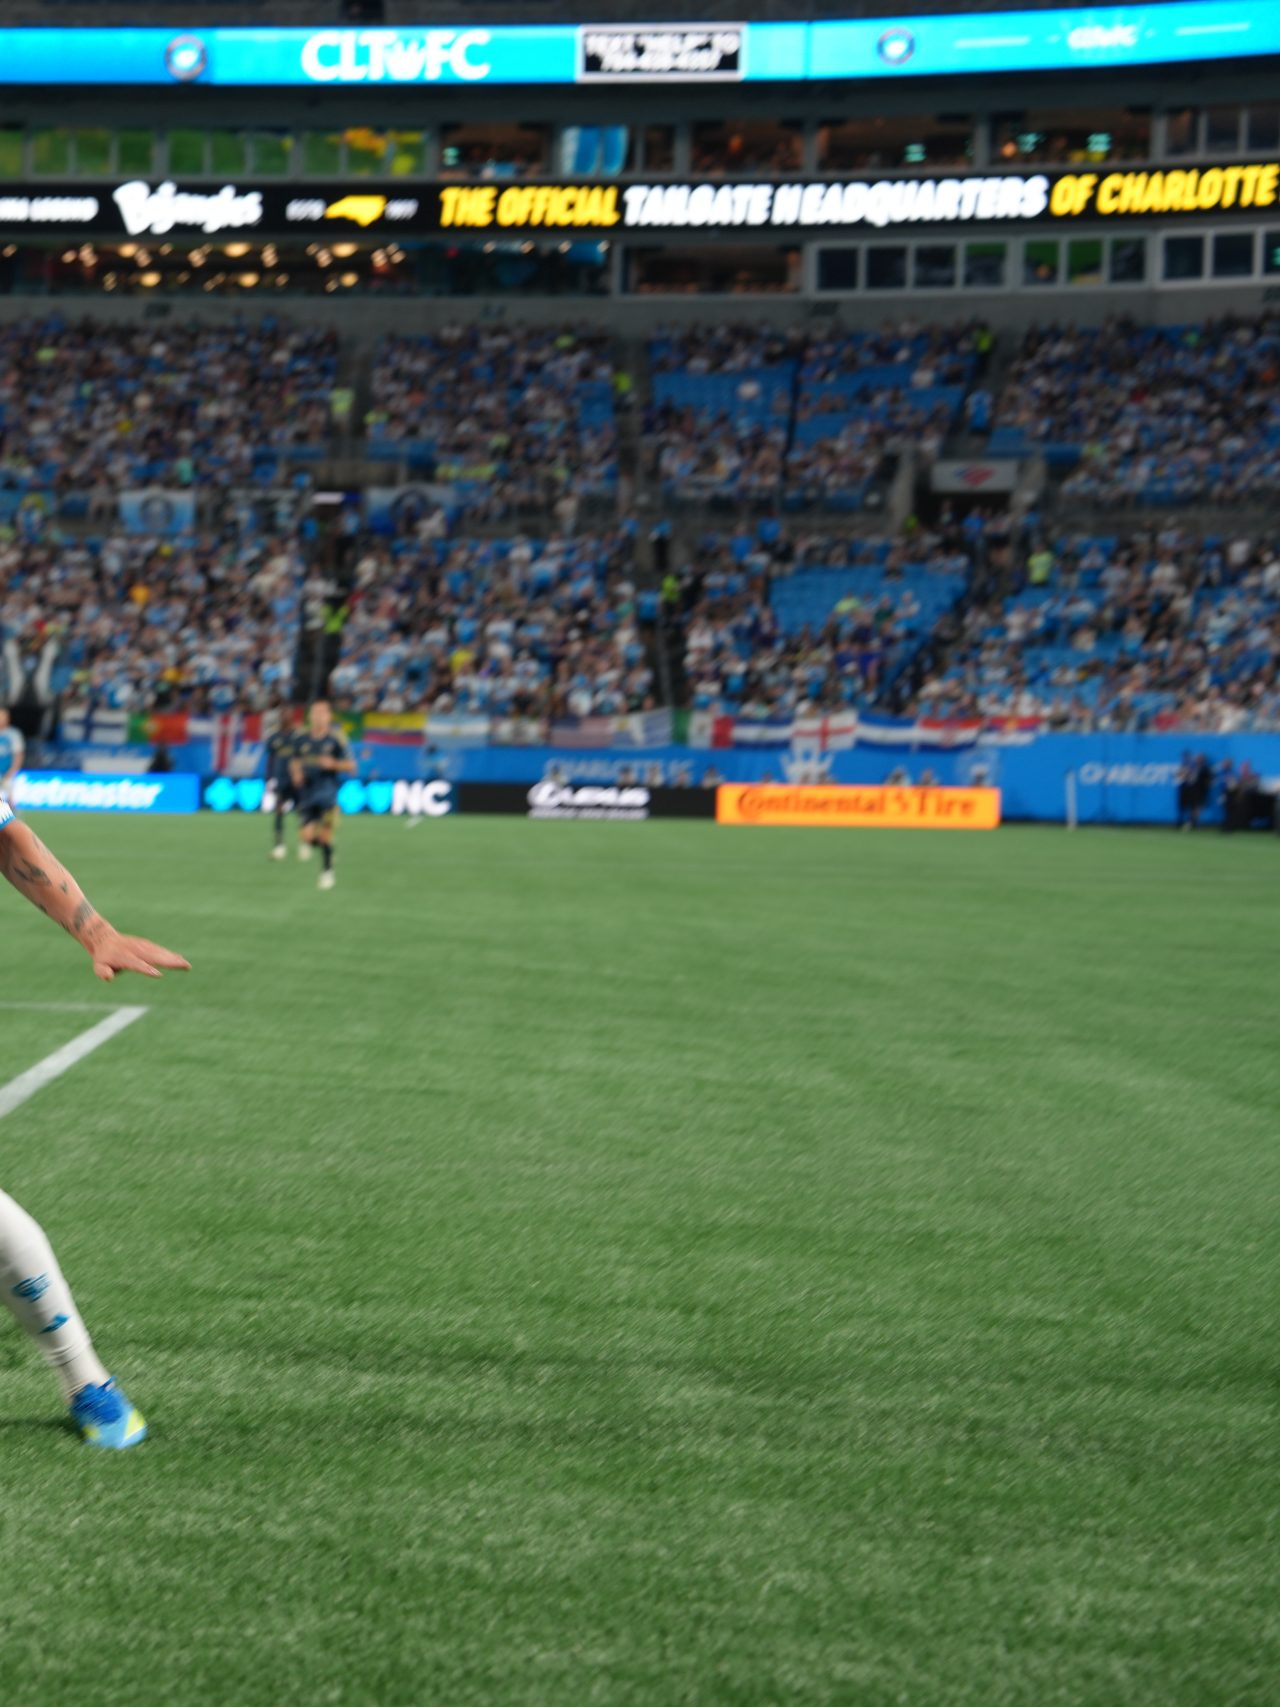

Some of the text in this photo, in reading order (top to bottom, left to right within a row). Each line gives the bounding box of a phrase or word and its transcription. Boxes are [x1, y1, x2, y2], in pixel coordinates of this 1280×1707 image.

[439, 185, 498, 227] THE
[496, 184, 620, 227] OFFICIAL
[623, 183, 772, 226] TAILGATE
[771, 174, 1049, 229] HEADQUARTERS
[1049, 173, 1099, 217] OF
[1096, 163, 1280, 215] CHARLOTTE
[13, 773, 164, 809] ketmaster
[391, 779, 452, 817] NC
[912, 787, 977, 817] Tire
